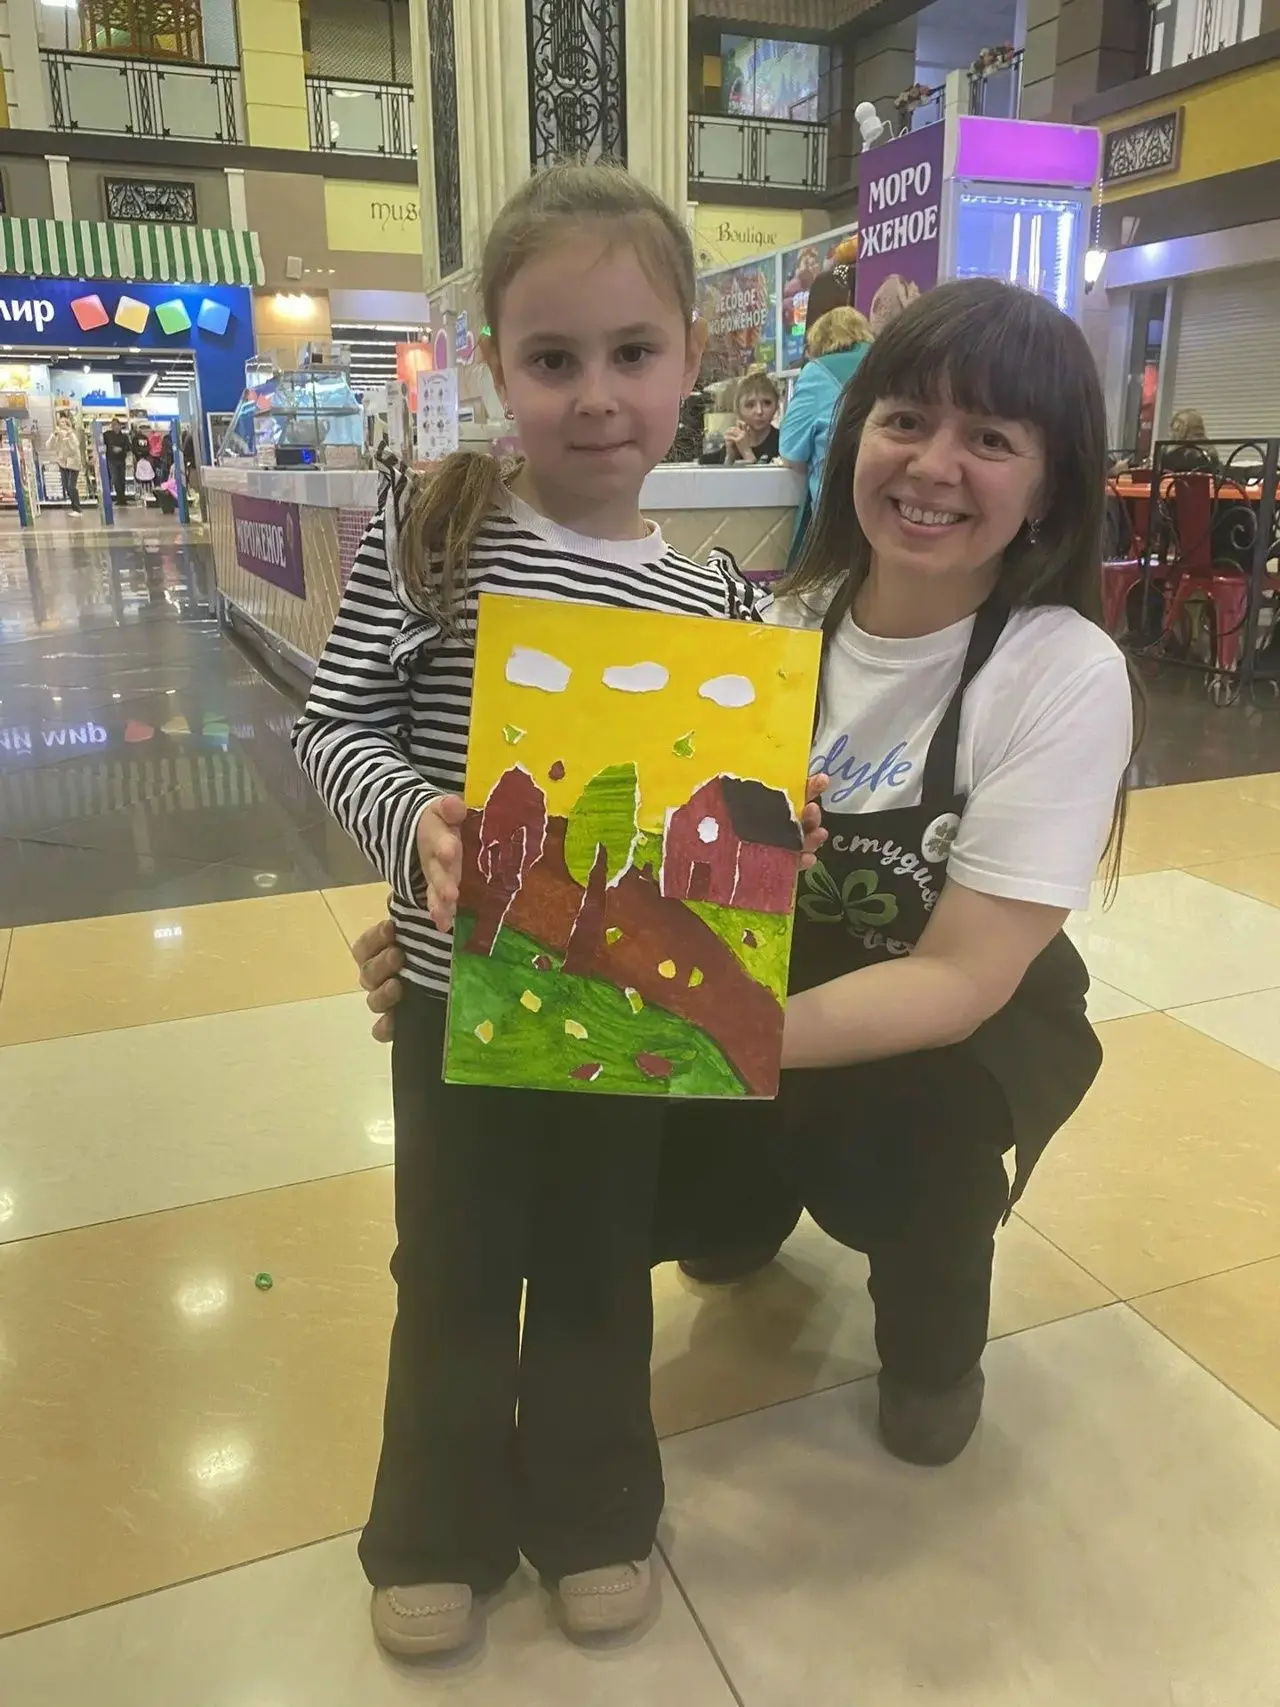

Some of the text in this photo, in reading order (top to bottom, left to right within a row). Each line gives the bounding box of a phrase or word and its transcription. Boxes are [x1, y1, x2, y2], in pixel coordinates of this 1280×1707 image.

[867, 162, 931, 214] МОРО
[370, 201, 421, 232] mus
[716, 221, 778, 247] Boutique
[859, 205, 939, 260] ЖЕНОЕ
[235, 518, 287, 568] МОРОЖЕНОЕ
